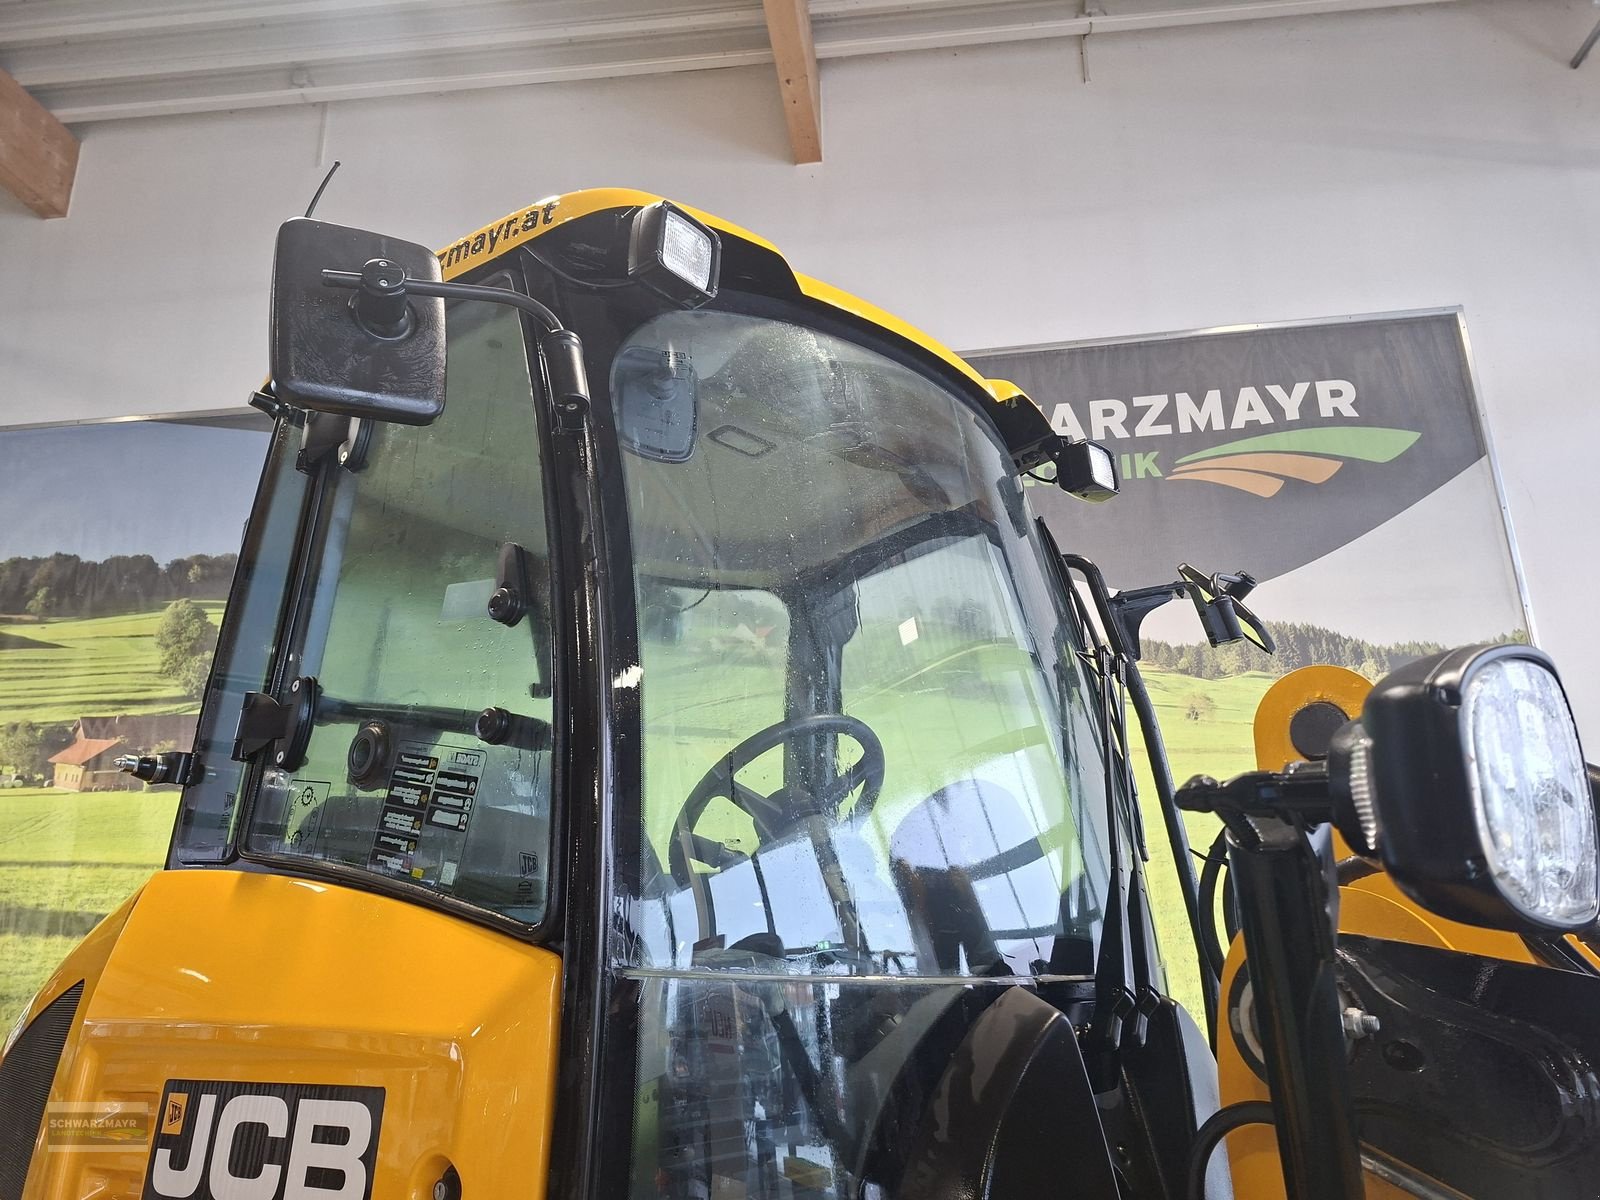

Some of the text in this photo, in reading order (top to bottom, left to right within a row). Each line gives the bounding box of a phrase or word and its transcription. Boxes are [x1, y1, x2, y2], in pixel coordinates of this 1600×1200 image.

[437, 202, 556, 270] zmayr.at
[1039, 379, 1360, 445] ARZMAYR
[521, 855, 537, 875] JCB
[152, 1094, 373, 1200] JCB
